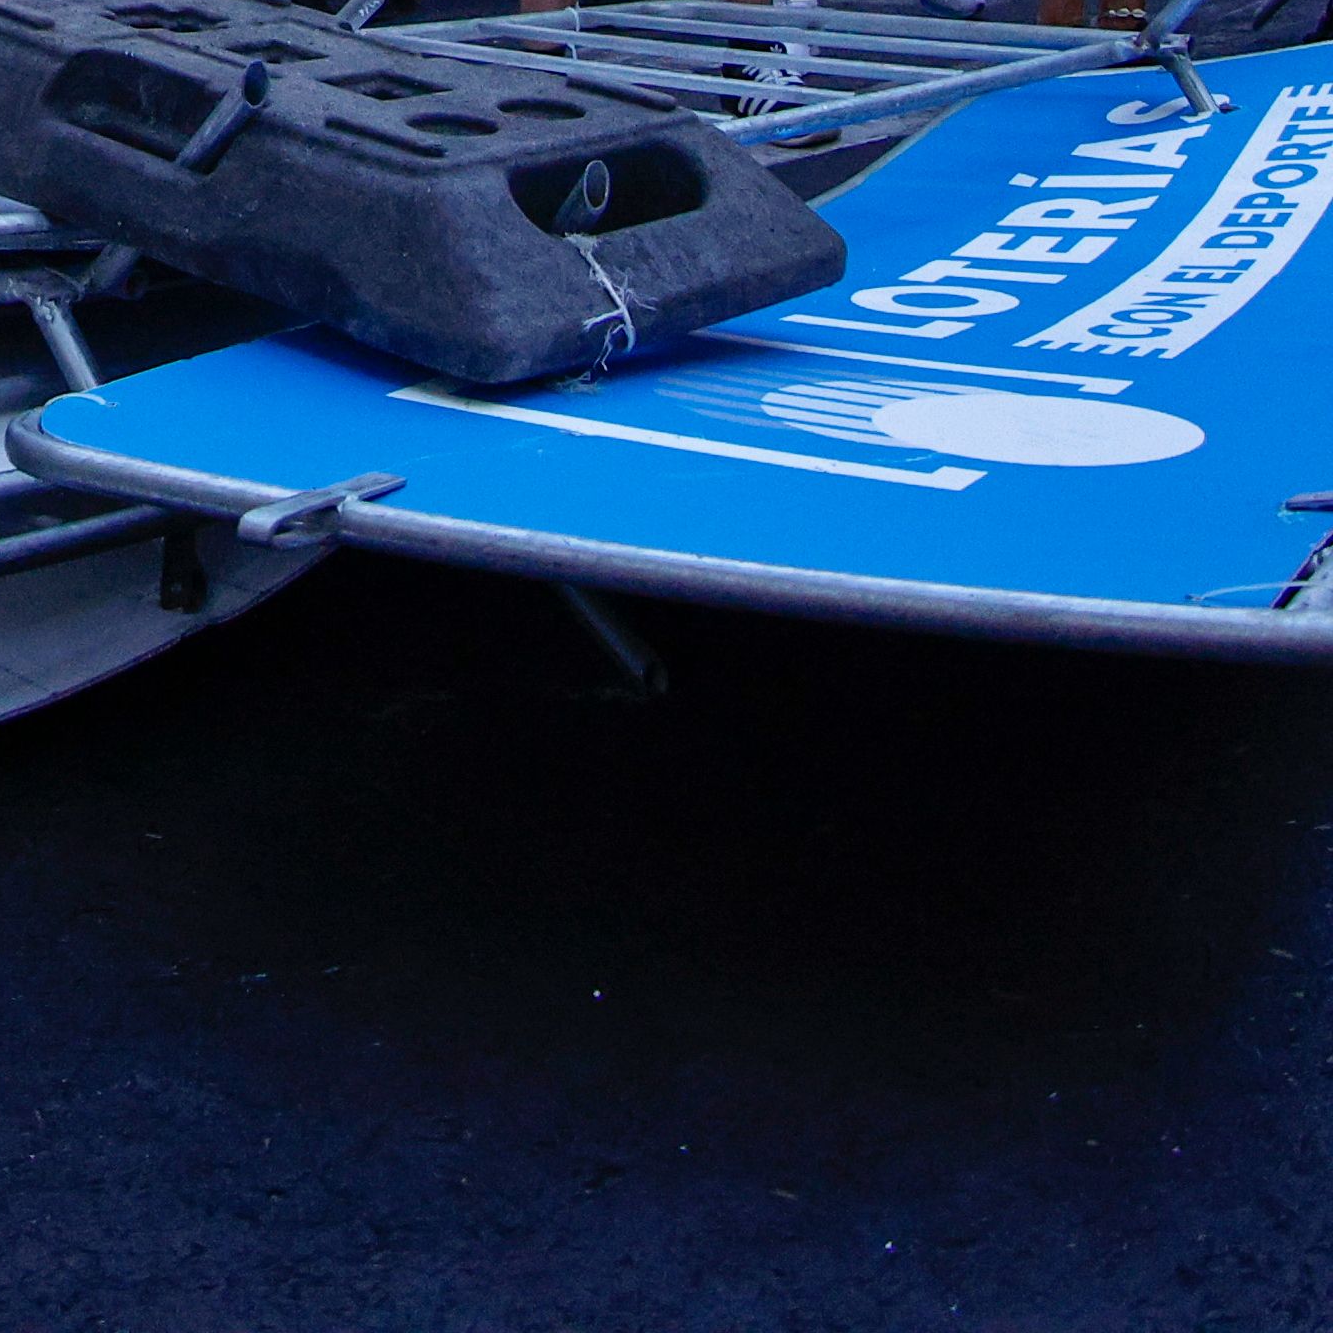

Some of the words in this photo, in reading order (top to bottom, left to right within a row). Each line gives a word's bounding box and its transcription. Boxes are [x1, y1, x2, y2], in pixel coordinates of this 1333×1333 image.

[779, 92, 1230, 339] LOTERÍAS
[1201, 106, 1333, 252] DEPORTE
[1088, 293, 1208, 339] CON
[1163, 259, 1256, 284] EL
